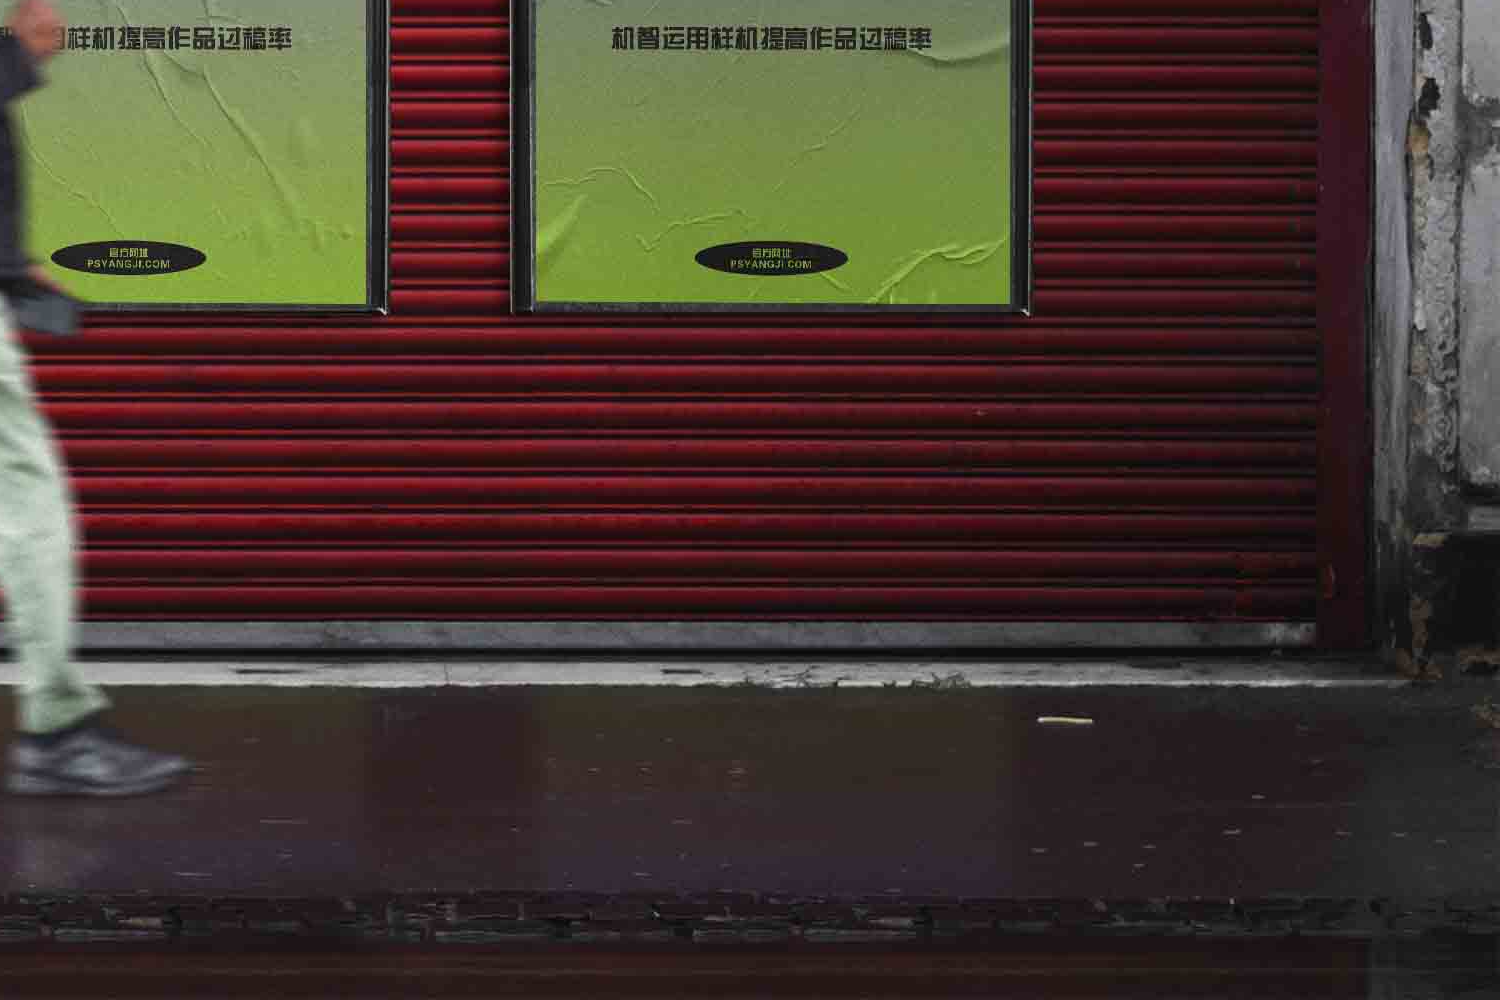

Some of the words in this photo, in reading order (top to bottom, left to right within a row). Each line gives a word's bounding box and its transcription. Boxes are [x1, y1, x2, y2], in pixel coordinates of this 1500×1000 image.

[611, 26, 932, 50] 机智运用样机提高作品过稿率
[87, 259, 170, 269] PSYANGJI.COM
[730, 259, 812, 269] PSYANGJI.COM
